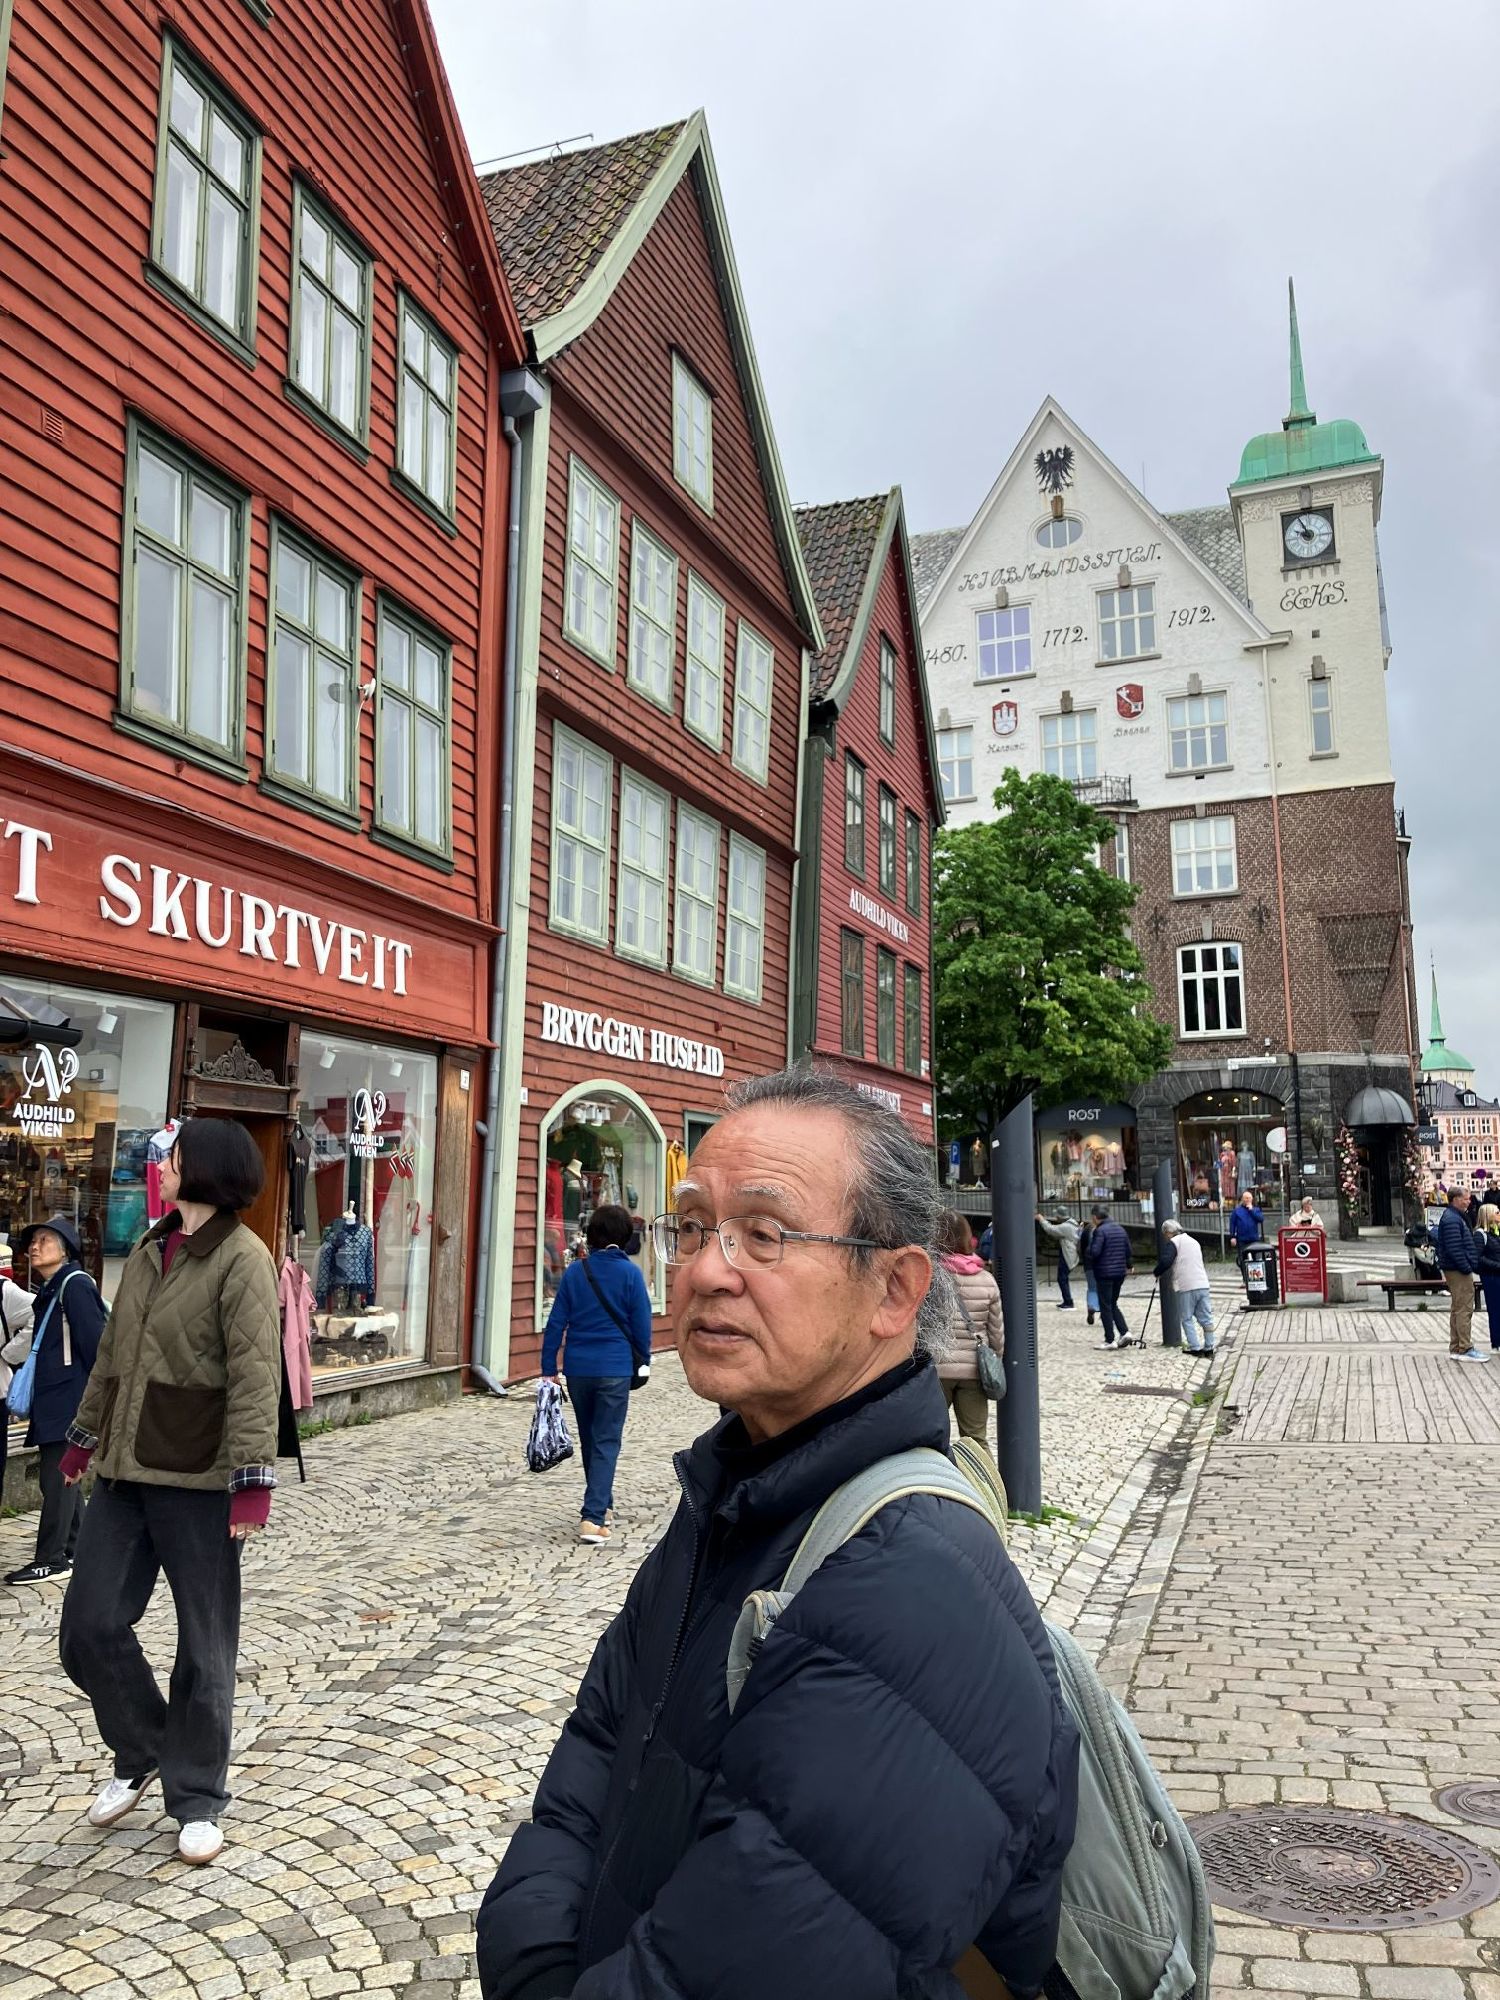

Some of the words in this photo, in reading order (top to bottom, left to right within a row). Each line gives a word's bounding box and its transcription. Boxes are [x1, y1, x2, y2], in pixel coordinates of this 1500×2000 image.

[1168, 605, 1216, 628] 1912.
[1042, 625, 1088, 648] 1712.
[100, 854, 412, 996] SKURTVEIT
[849, 887, 887, 929] AUDHILD
[886, 911, 909, 945] VIKEN
[541, 1001, 645, 1062] BRYGGEN
[650, 1029, 725, 1078] HUSFLID
[12, 1103, 76, 1123] AUDHILD
[21, 1120, 63, 1138] VIKEN
[349, 1132, 385, 1148] AUDHILD
[353, 1145, 378, 1158] VIKEN
